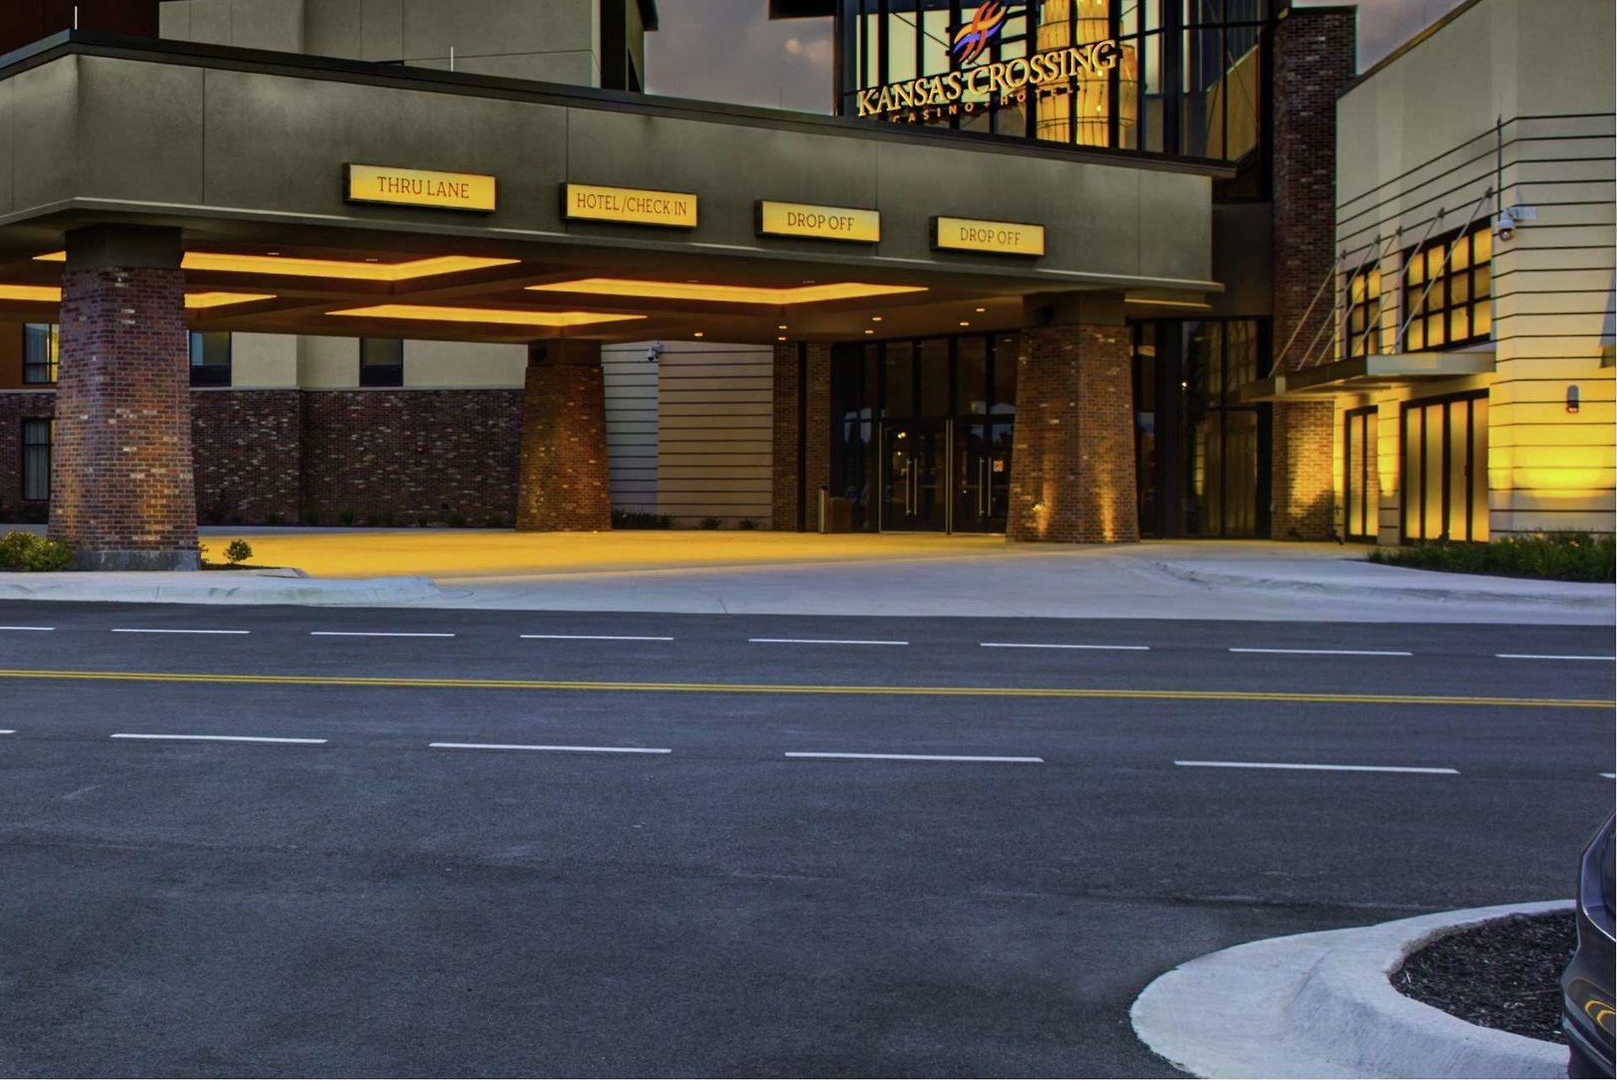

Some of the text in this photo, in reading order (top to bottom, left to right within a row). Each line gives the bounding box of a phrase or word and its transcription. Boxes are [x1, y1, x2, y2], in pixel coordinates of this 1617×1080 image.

[857, 38, 1117, 117] KANSAS CROSSING
[892, 102, 975, 124] CASINO
[377, 176, 470, 199] THRU LANE
[787, 211, 855, 232] DROP OFF
[960, 227, 1022, 245] DROP OFF
